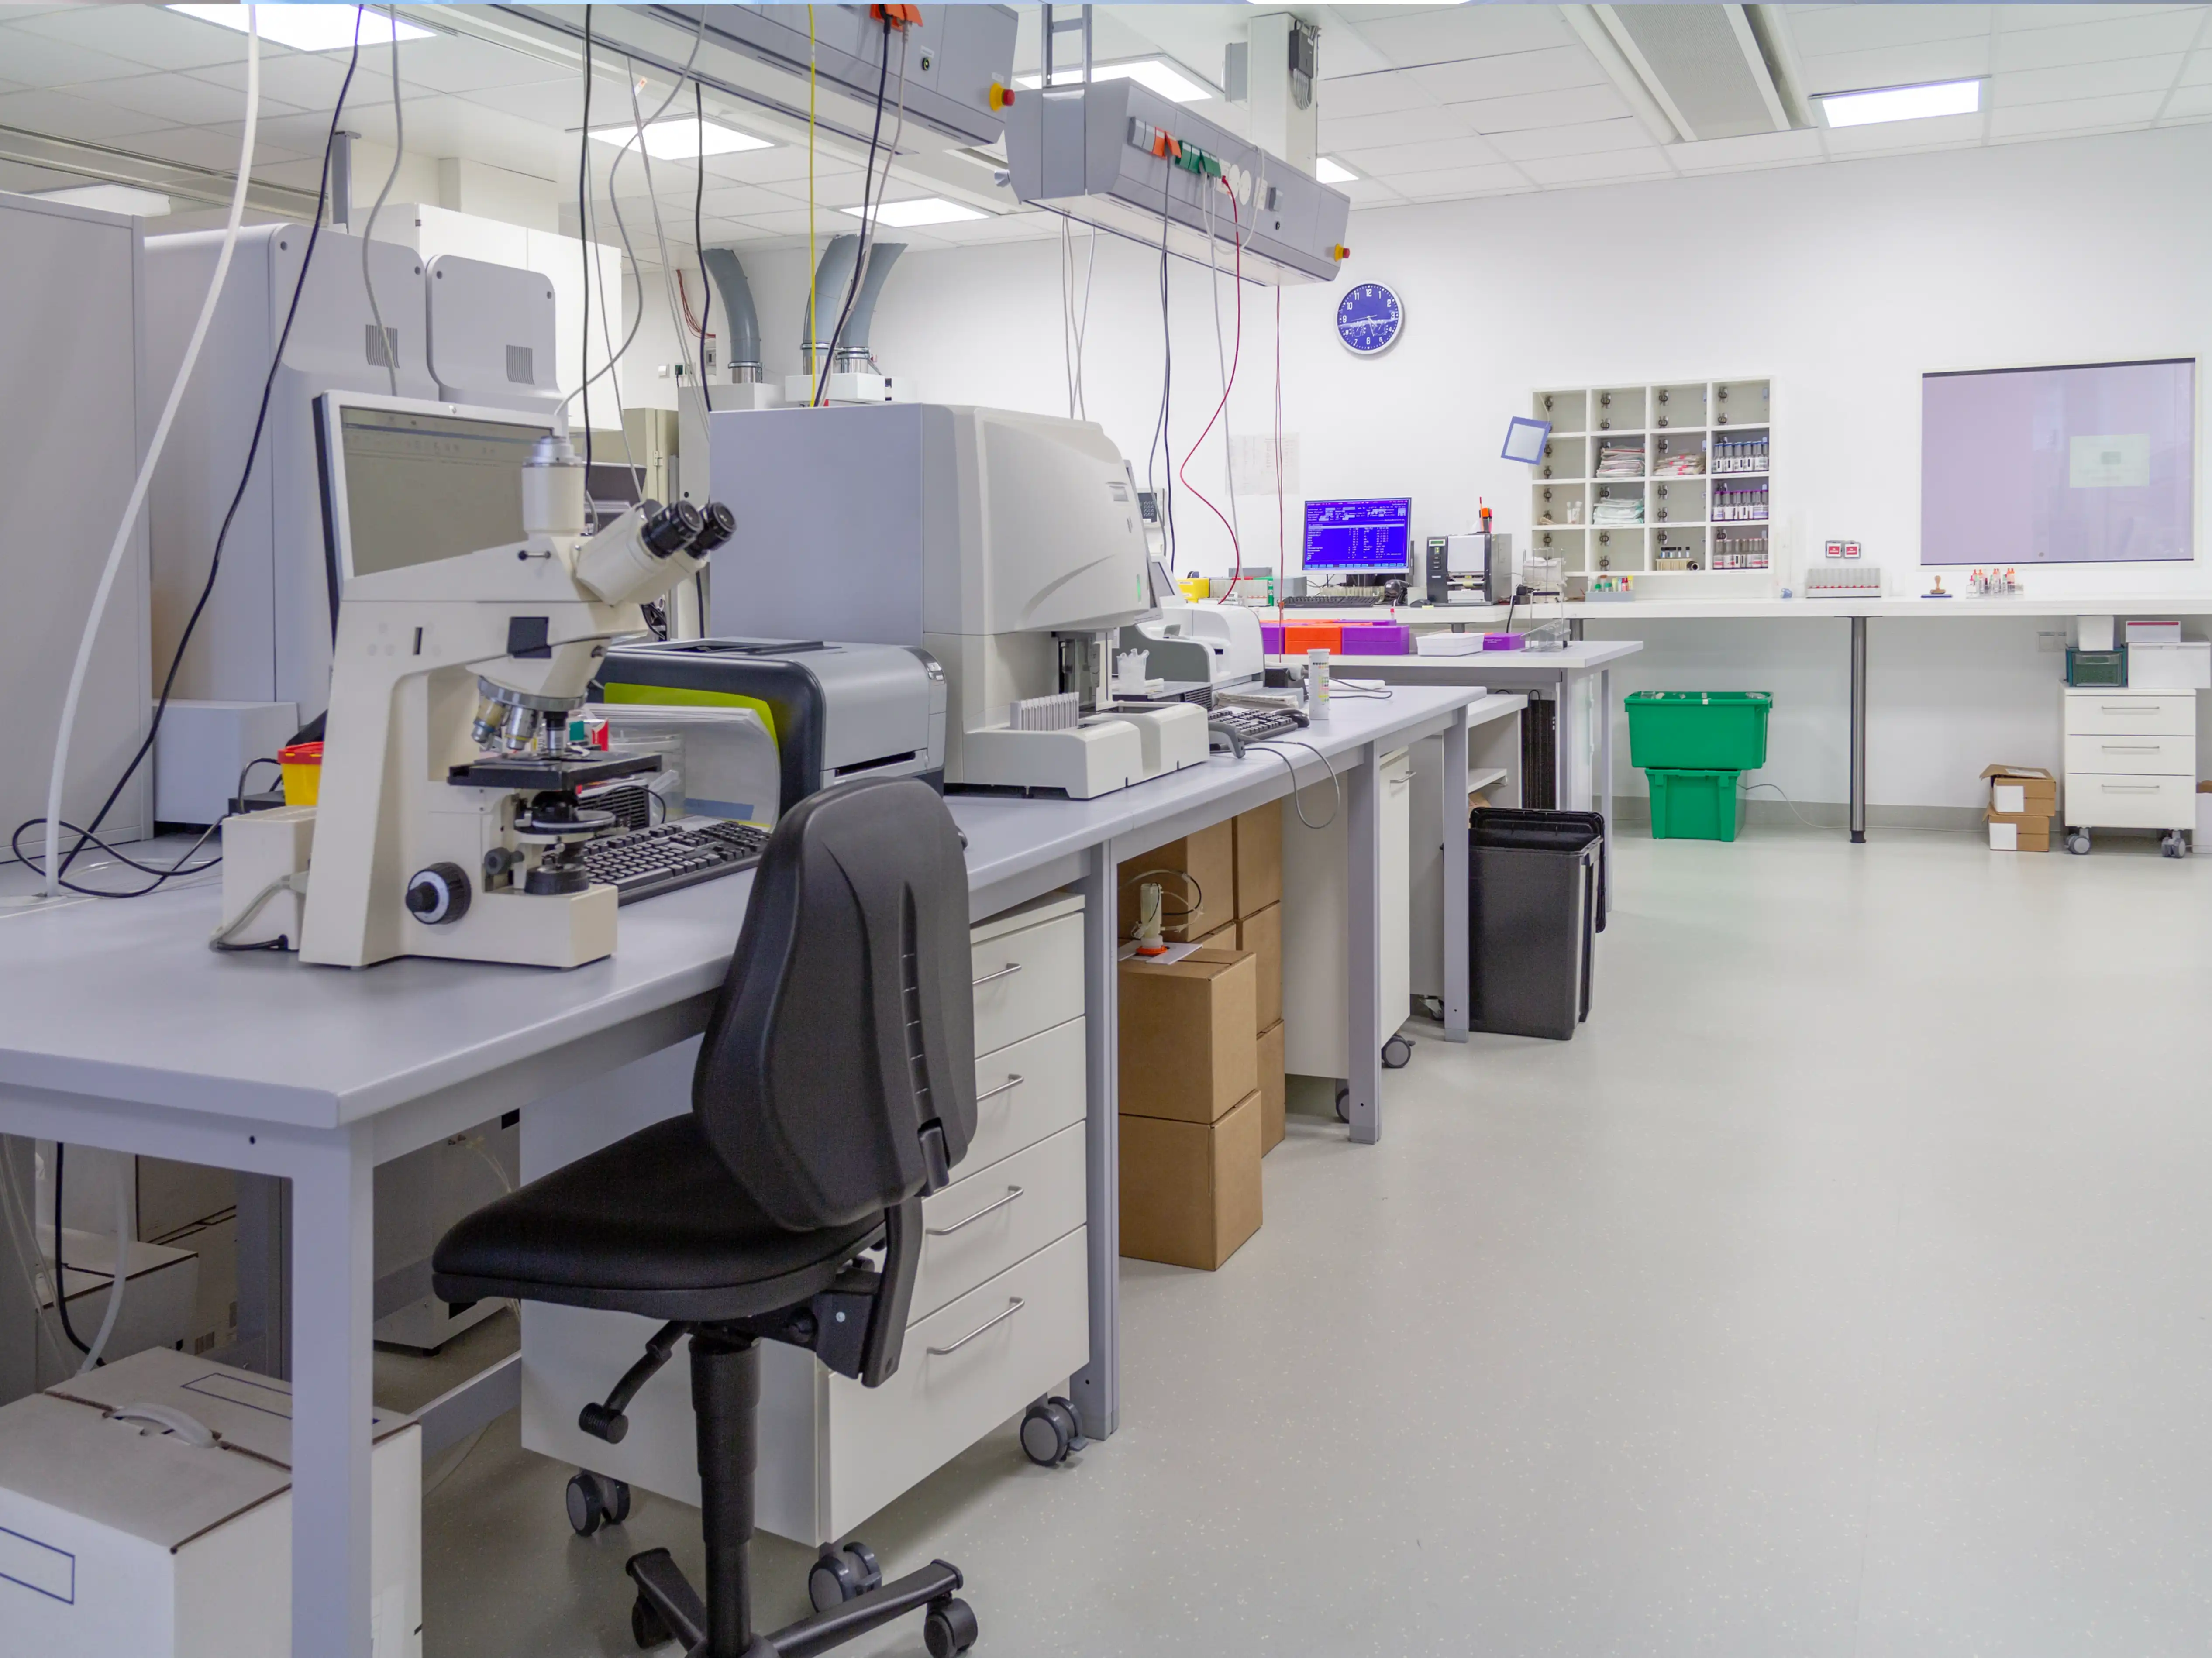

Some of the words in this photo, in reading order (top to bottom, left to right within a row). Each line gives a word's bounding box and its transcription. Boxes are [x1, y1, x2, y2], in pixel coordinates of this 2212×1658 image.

[1354, 292, 1360, 300] 11
[1365, 289, 1372, 297] 12
[1378, 291, 1382, 299] 1
[1347, 302, 1353, 310] 10
[1387, 299, 1392, 307] 2
[1391, 311, 1395, 320] 3
